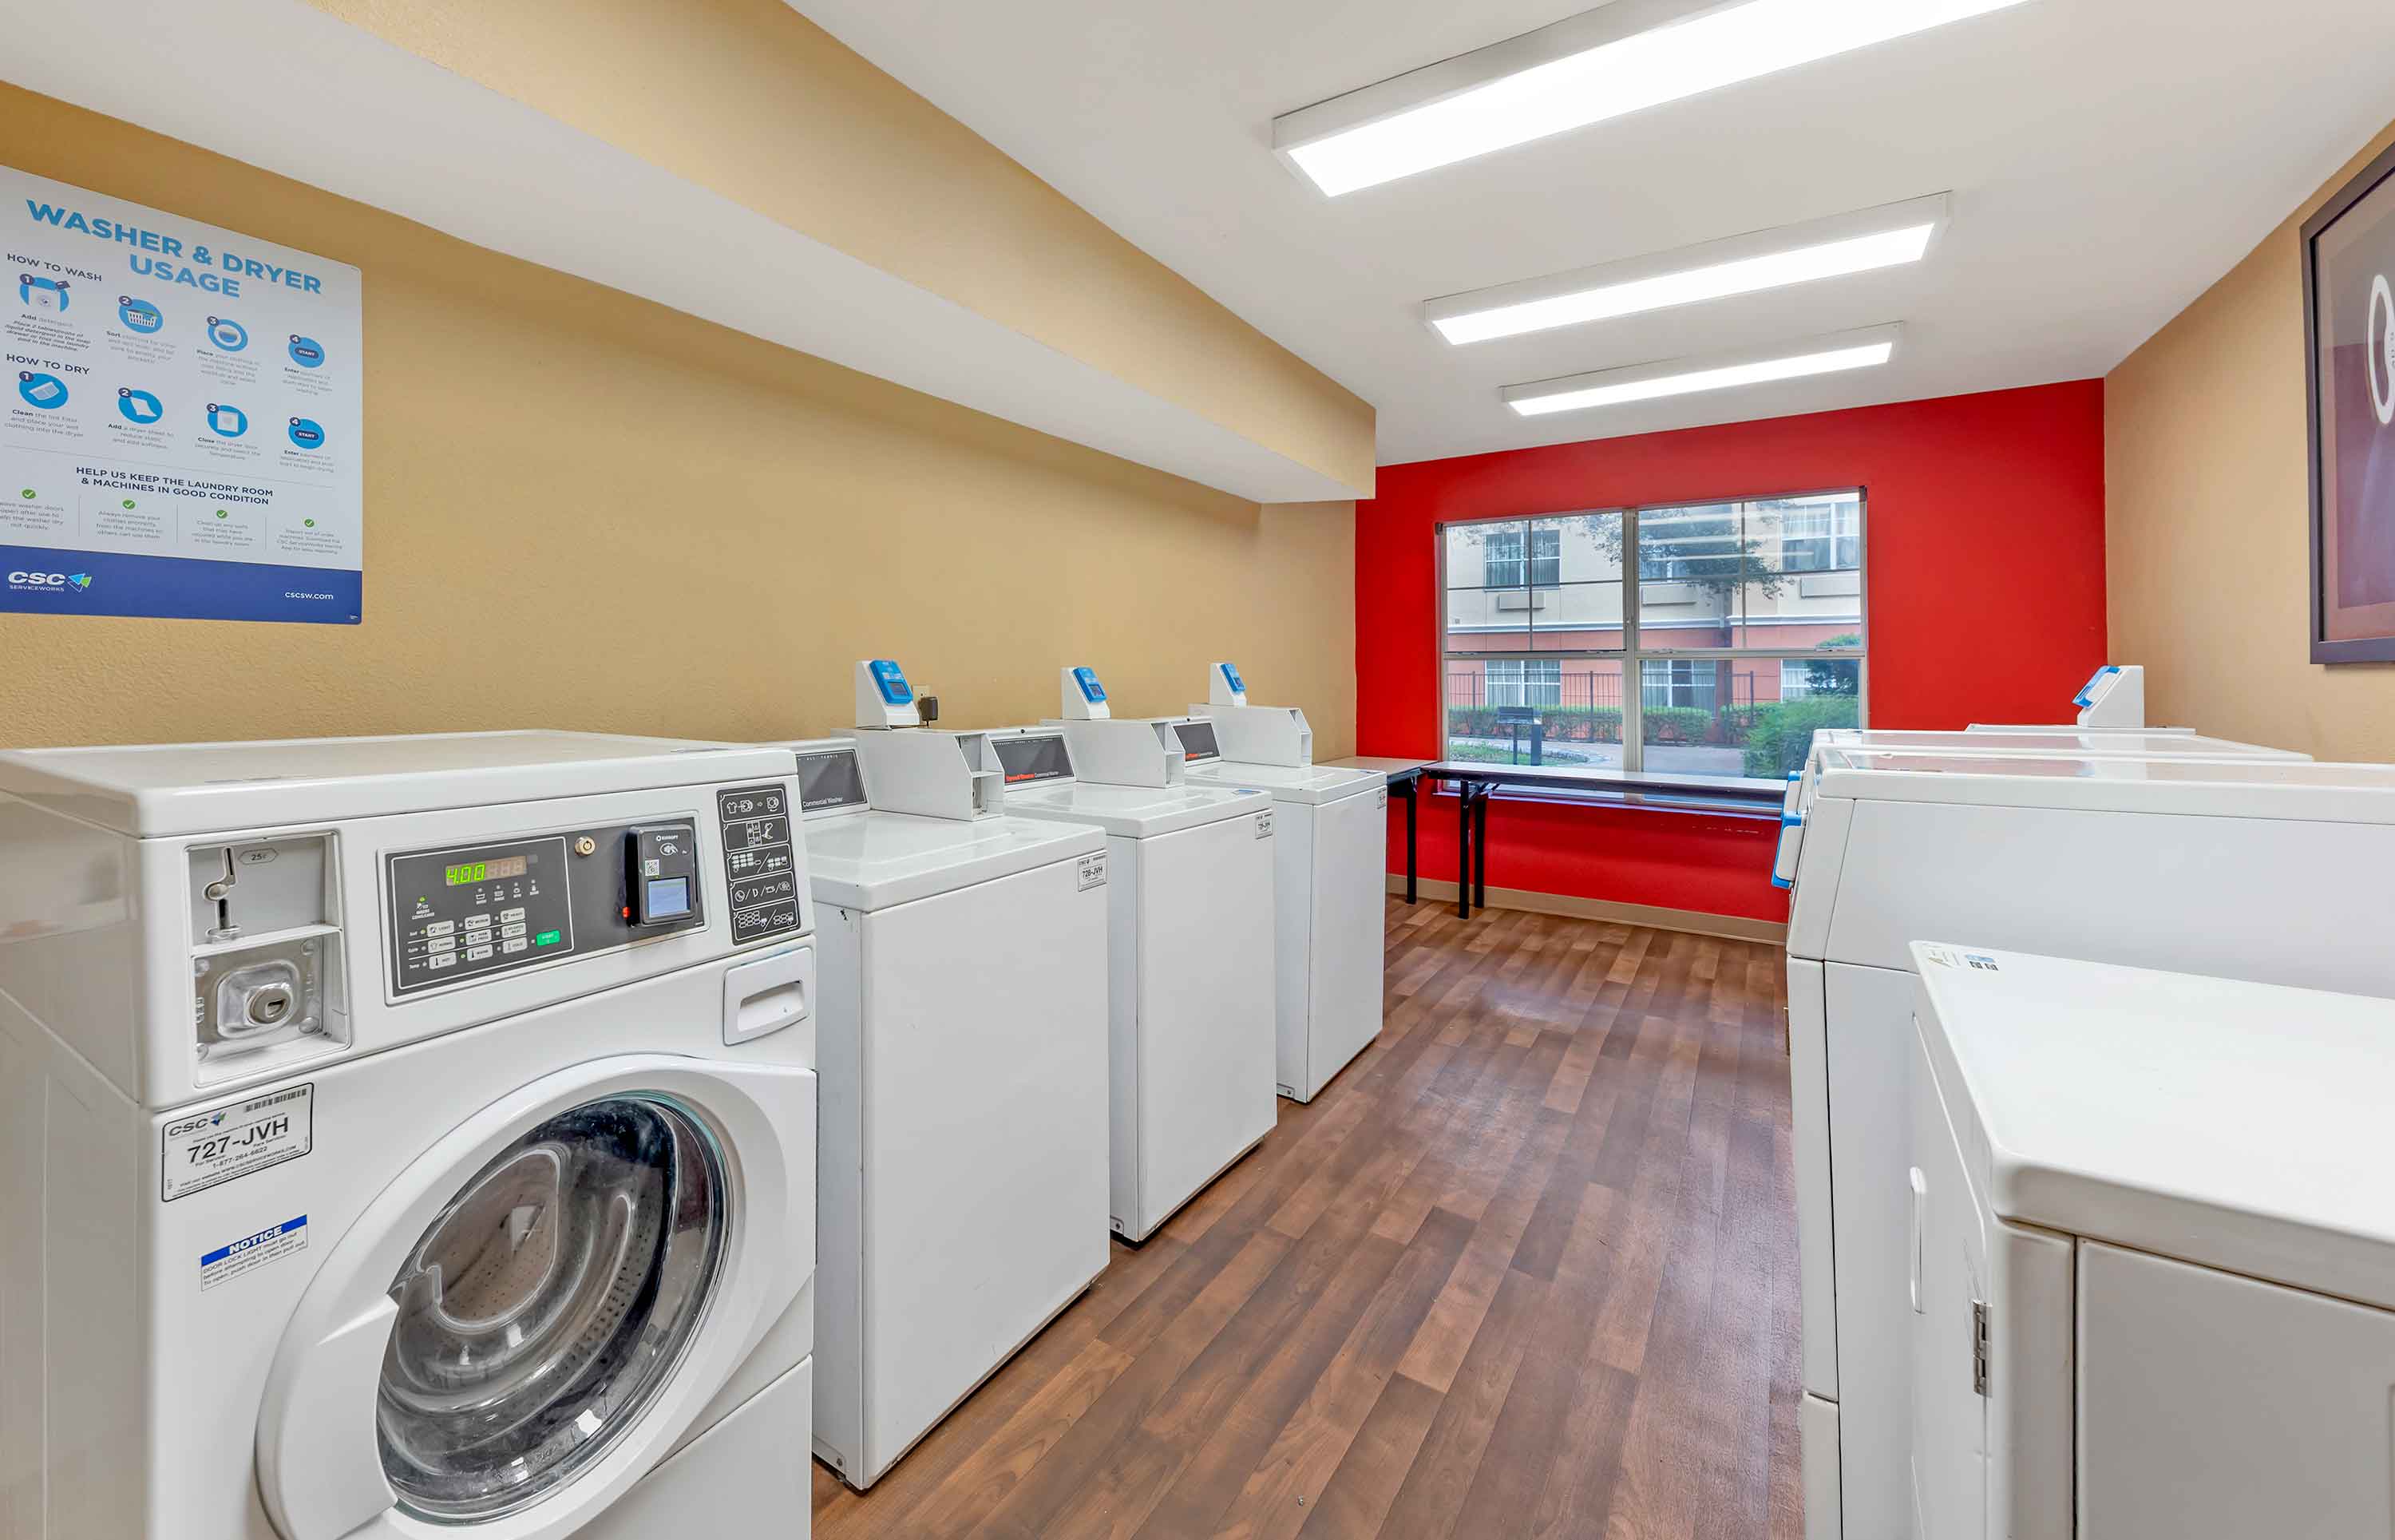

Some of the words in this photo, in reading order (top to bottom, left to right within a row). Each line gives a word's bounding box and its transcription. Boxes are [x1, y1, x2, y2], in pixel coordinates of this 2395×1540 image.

[26, 199, 183, 259] WASHER
[192, 245, 213, 266] &
[223, 252, 322, 294] DRYER
[7, 253, 40, 267] HOW
[44, 262, 61, 272] TO
[65, 266, 102, 281] WASH
[130, 254, 241, 298] USAGE
[6, 354, 39, 366] HOW
[42, 360, 61, 370] TO
[65, 364, 90, 375] DRY
[77, 466, 108, 477] HELP
[111, 470, 127, 480] US
[130, 473, 160, 483] KEEP
[163, 477, 184, 487] THE
[188, 480, 239, 493] LAUNDRY
[242, 487, 273, 497] ROOM
[93, 479, 155, 492] MACHINES
[158, 485, 169, 494] IN
[173, 488, 206, 498] GOOD
[210, 492, 269, 505] CONDITION
[8, 572, 65, 585] CSC
[802, 797, 827, 807] Commercial
[447, 864, 485, 885] 4.00
[168, 1118, 208, 1136] CSC
[188, 1116, 288, 1163] 727-JVH
[229, 1225, 283, 1255] NOTICE
